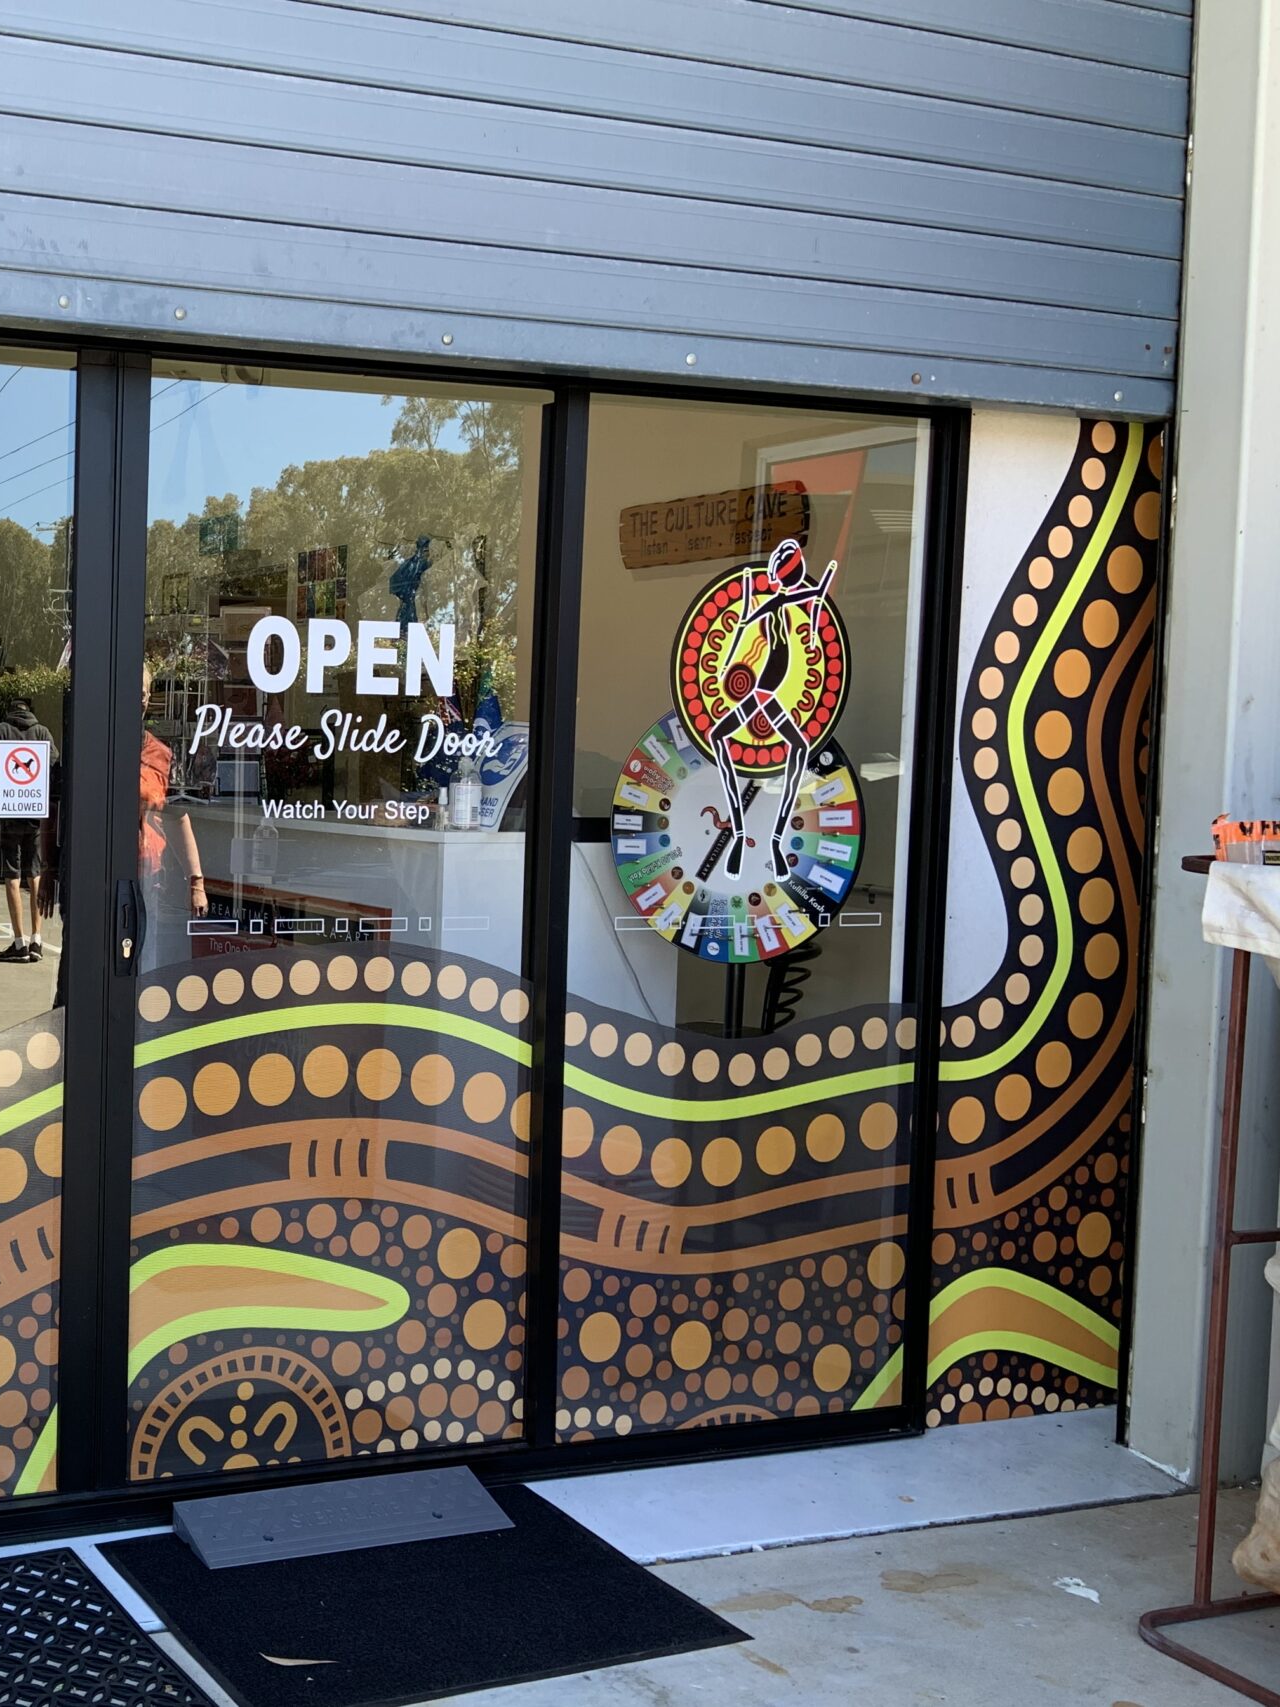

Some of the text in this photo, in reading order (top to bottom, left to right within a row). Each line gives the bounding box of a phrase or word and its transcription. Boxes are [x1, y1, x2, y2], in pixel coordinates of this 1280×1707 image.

[630, 489, 788, 538] THE CULTURE CAVE
[247, 615, 455, 697] OPEN
[189, 704, 503, 763] Please Slide Door
[1, 802, 43, 812] ALLOWED
[3, 789, 42, 798] NO DOGS
[262, 799, 326, 820] Watch
[332, 800, 380, 820] Your
[384, 800, 430, 824] Step
[787, 878, 811, 900] Kullilla
[808, 896, 827, 913] Kash
